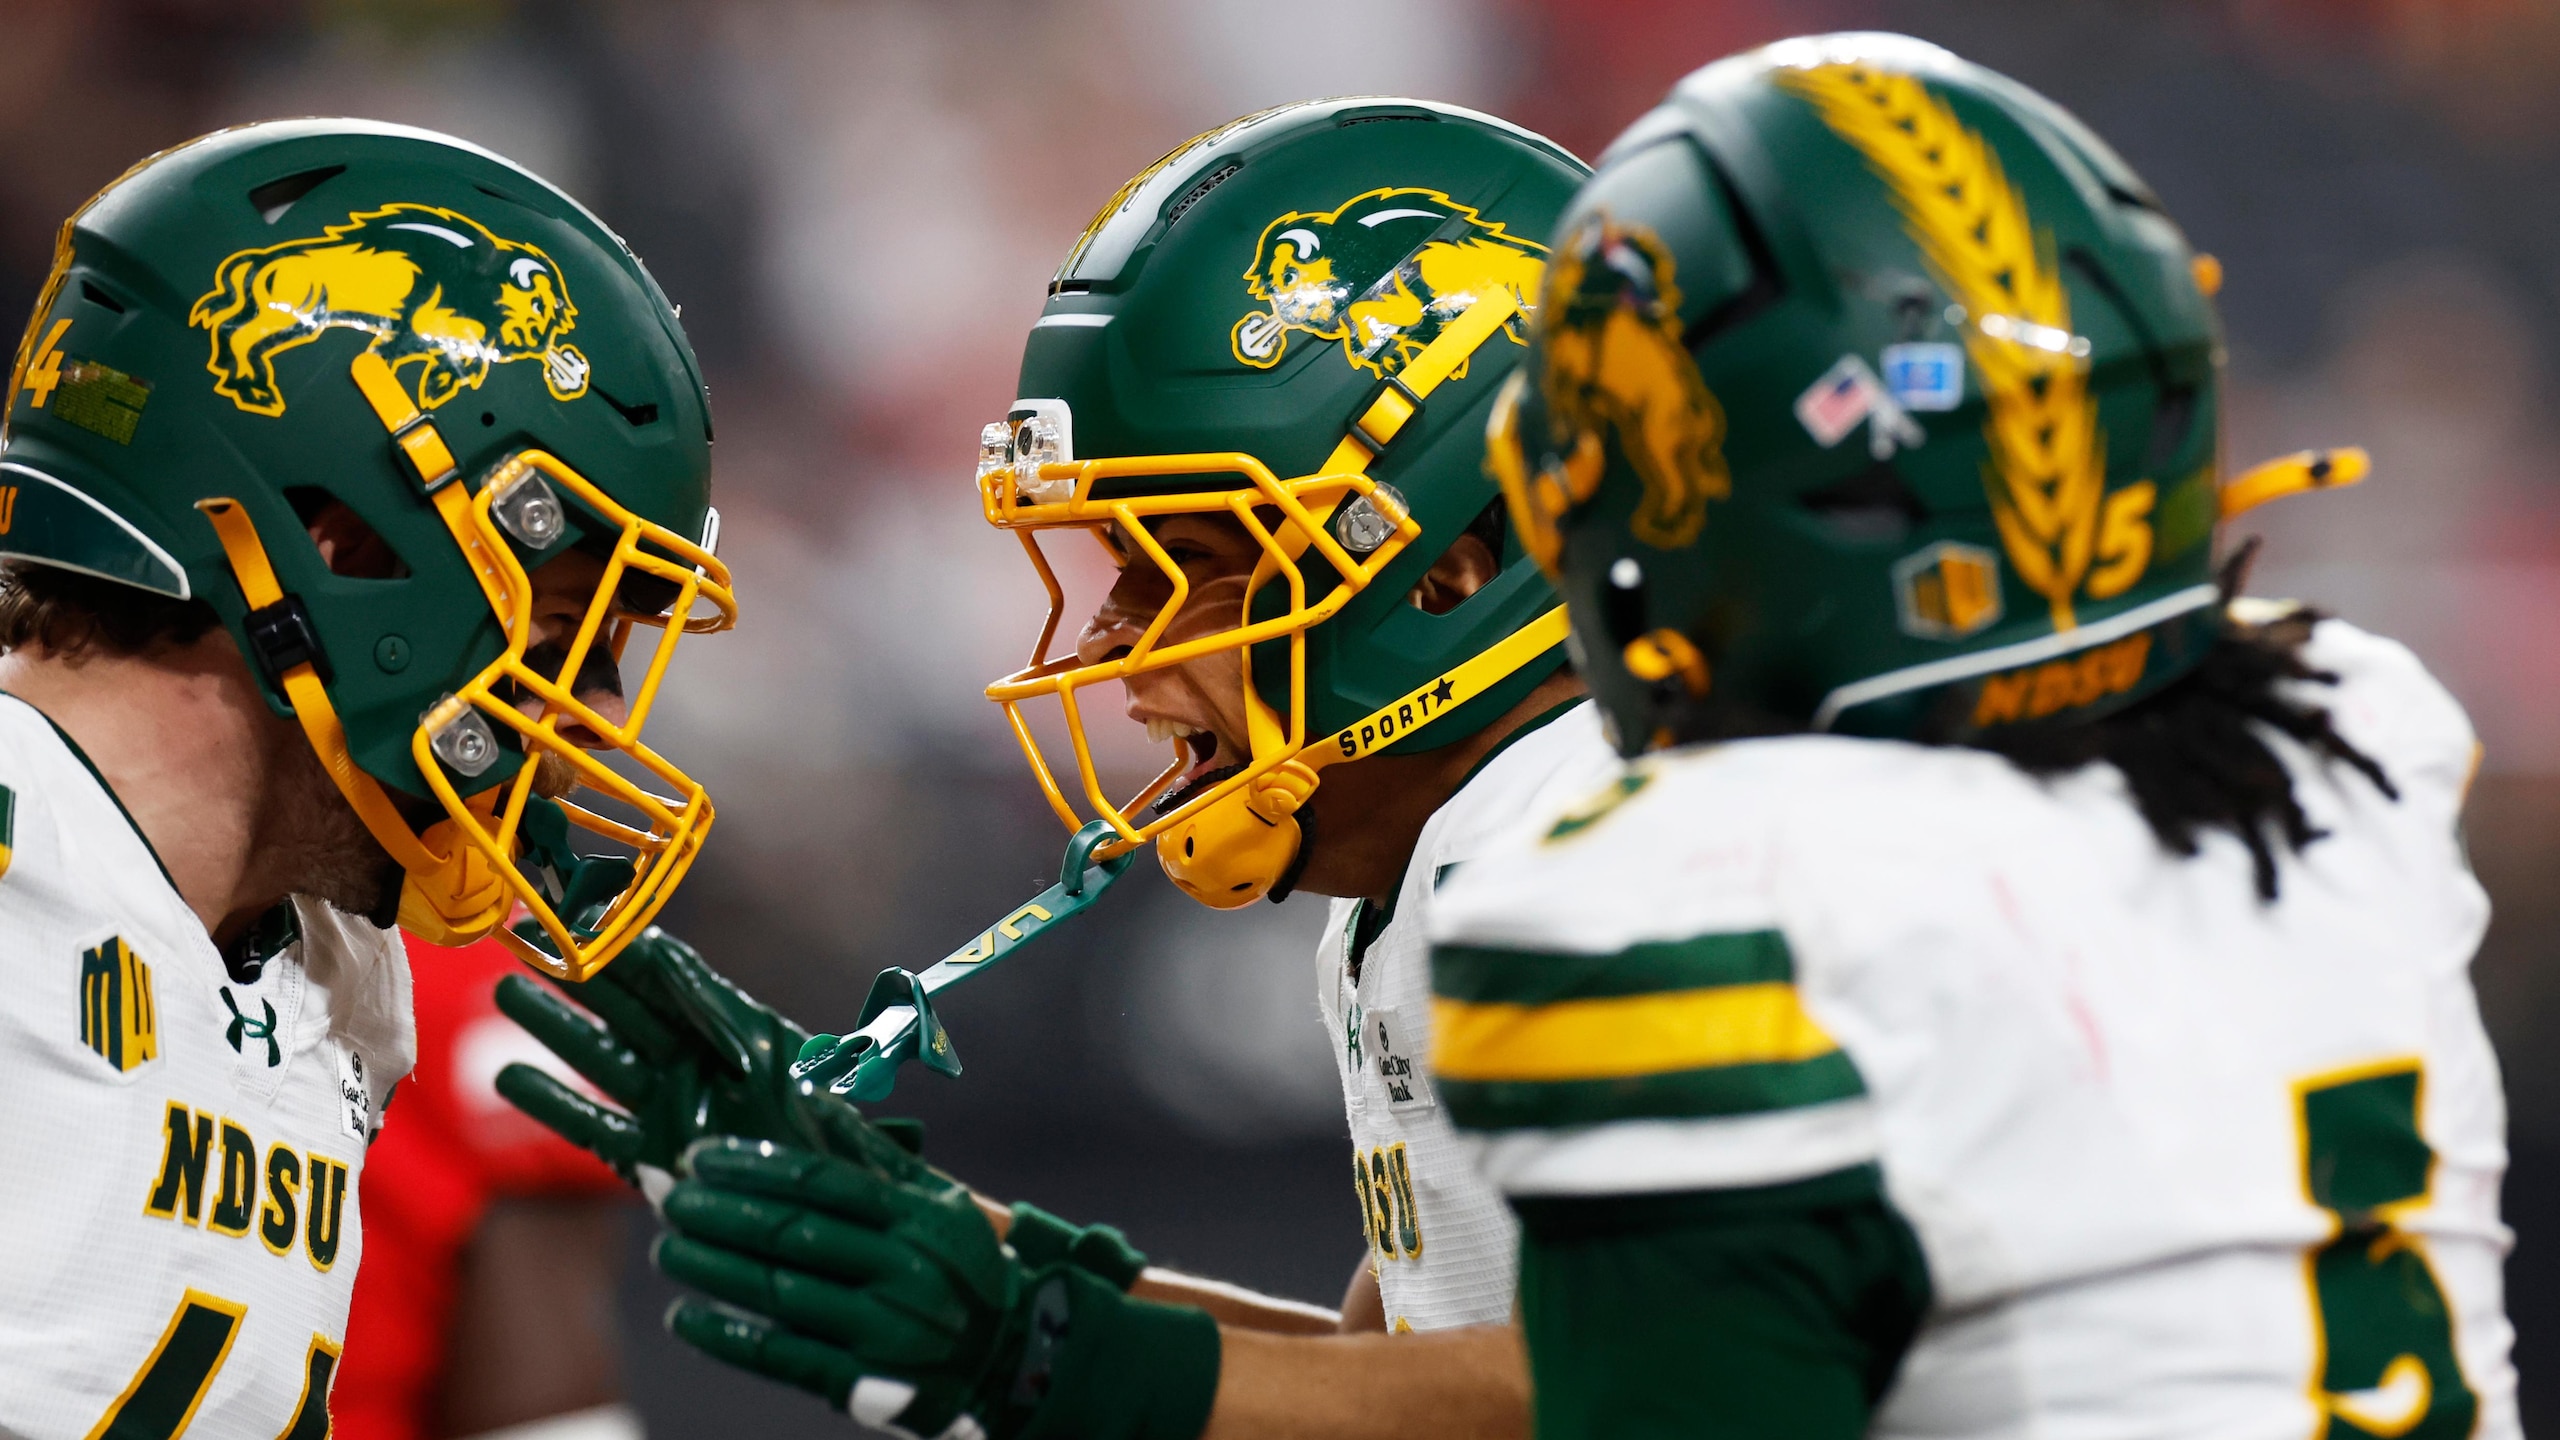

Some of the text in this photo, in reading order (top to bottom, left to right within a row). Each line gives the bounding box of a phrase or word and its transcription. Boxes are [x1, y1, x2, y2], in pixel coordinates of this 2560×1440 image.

[22, 318, 74, 409] 4
[2086, 478, 2158, 599] 5
[1338, 692, 1430, 757] SPORT
[945, 903, 1054, 963] UA
[1387, 1079, 1414, 1103] Bank
[1390, 1054, 1412, 1080] City
[143, 1099, 350, 1273] NDSU
[1355, 1140, 1424, 1261] DSU
